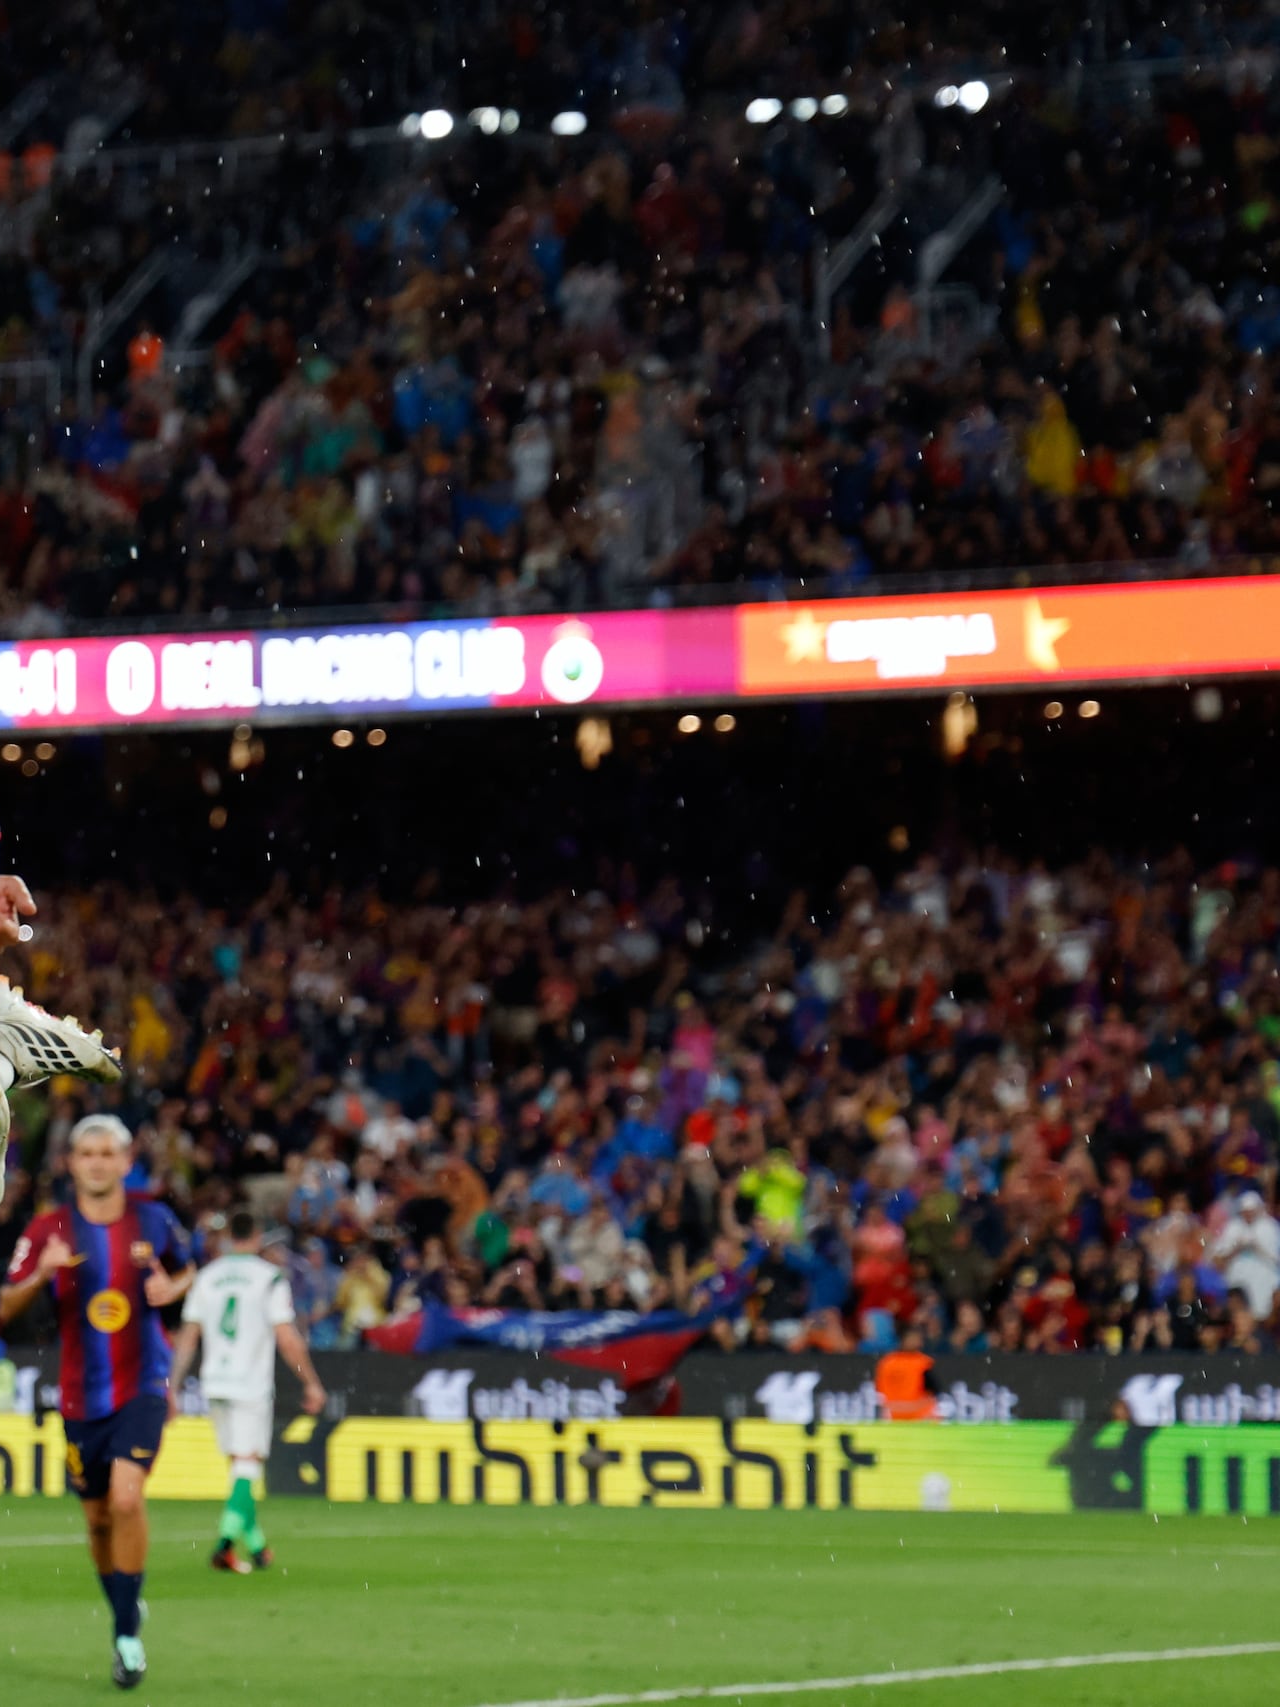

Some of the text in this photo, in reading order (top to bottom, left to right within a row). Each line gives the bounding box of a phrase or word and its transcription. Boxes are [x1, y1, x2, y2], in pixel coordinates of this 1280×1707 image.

[161, 641, 261, 708] REAL
[415, 627, 524, 698] CLUB
[218, 1296, 239, 1341] 4
